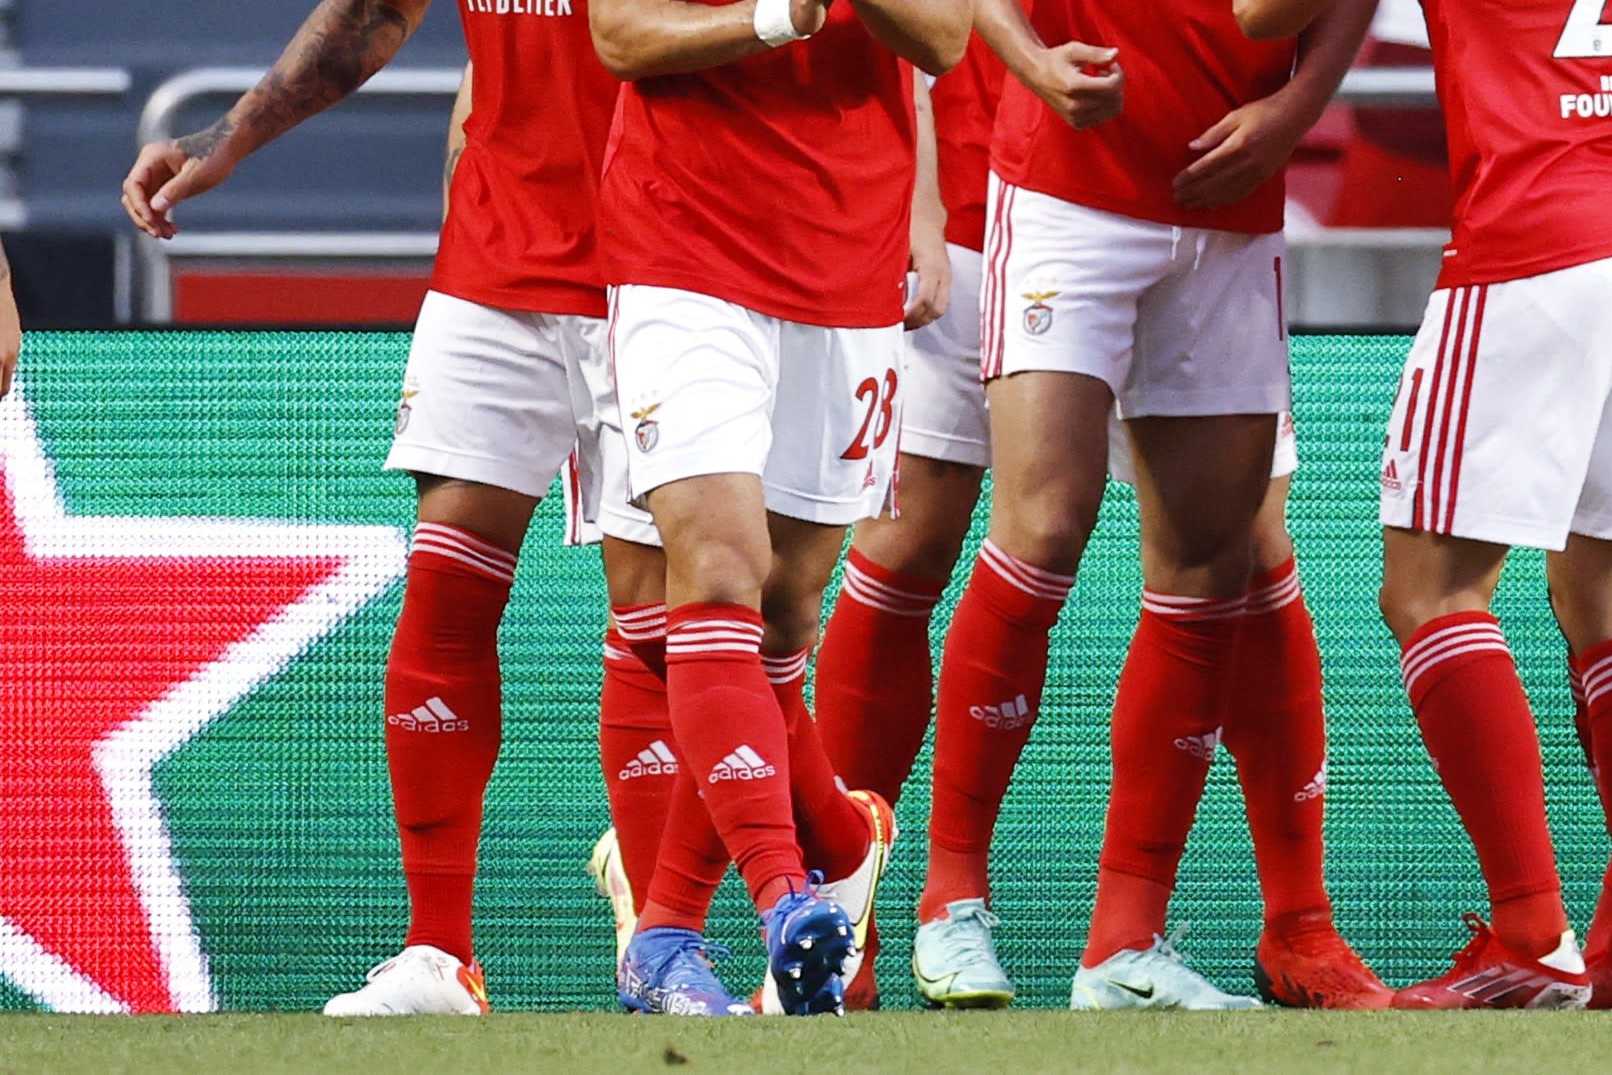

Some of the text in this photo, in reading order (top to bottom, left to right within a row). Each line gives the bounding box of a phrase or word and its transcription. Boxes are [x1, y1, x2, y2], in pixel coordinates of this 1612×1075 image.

[839, 367, 898, 460] 28
[388, 713, 470, 734] adidas
[708, 765, 776, 784] adidas
